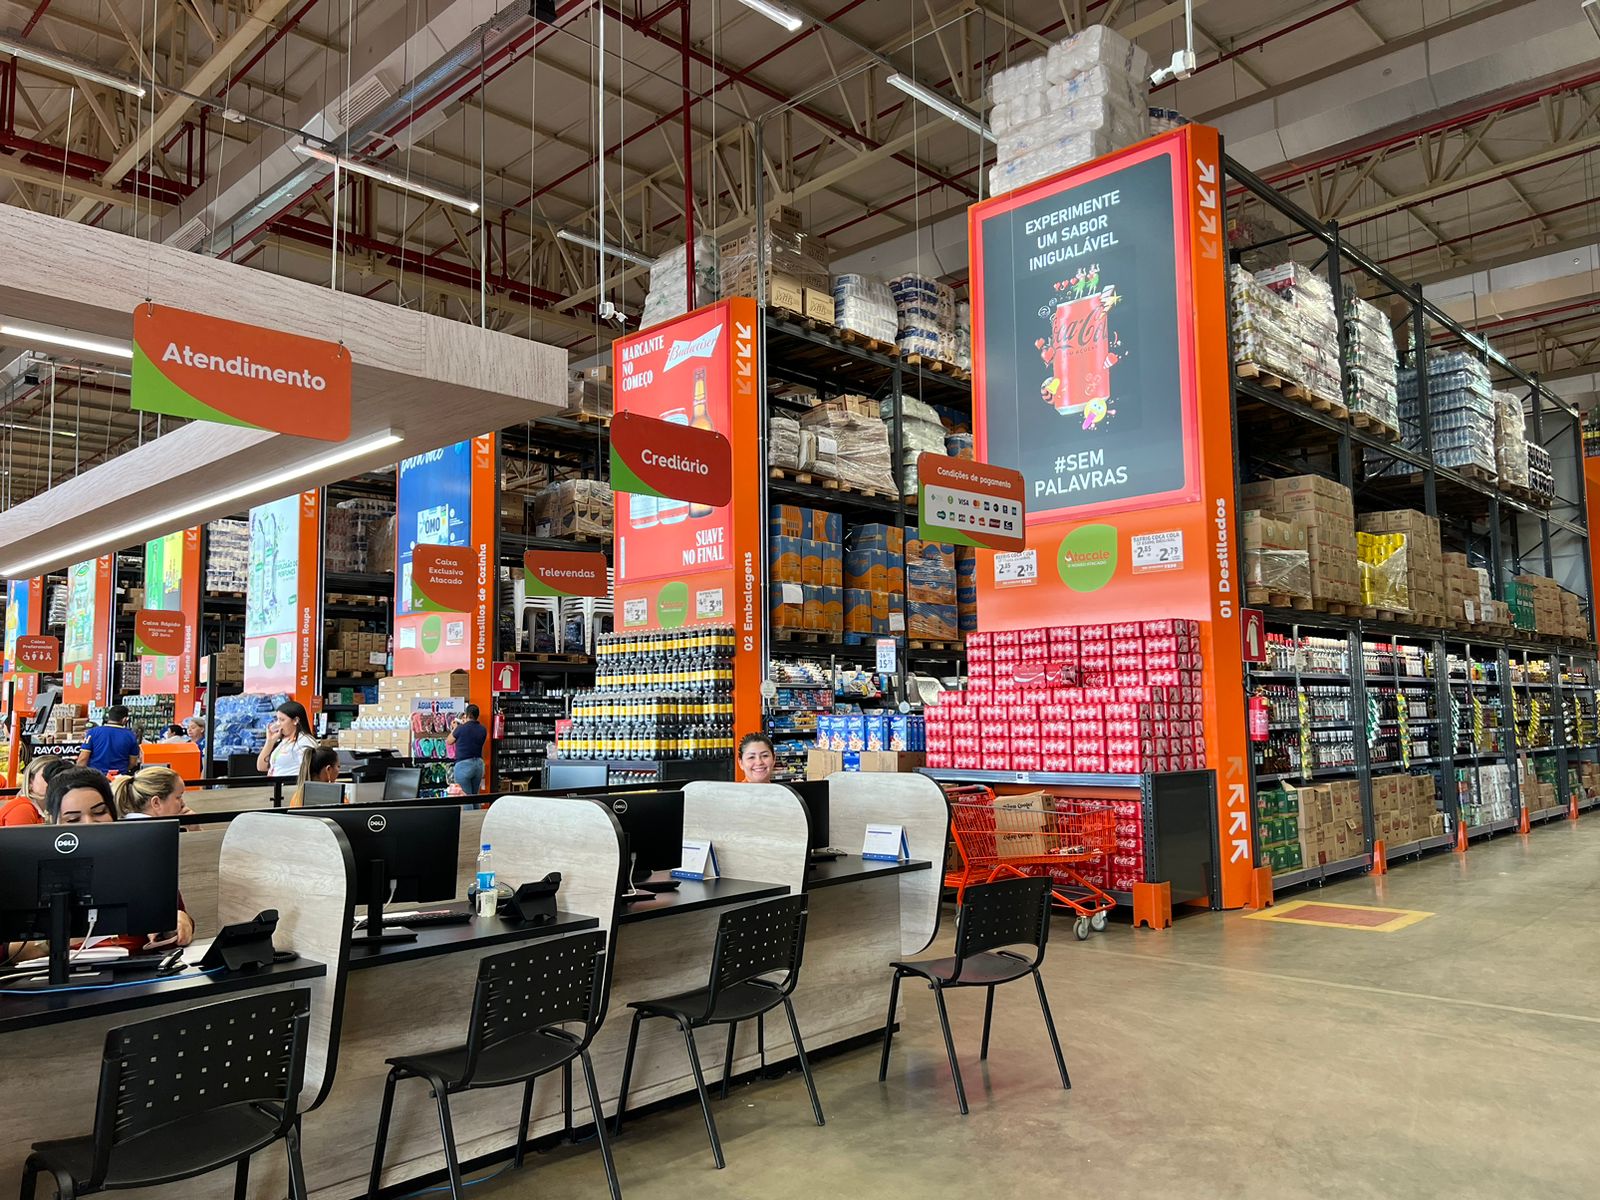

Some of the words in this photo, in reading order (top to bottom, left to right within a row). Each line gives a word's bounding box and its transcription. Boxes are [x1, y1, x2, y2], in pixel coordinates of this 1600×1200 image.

[1025, 190, 1121, 235] EXPERIMENTE
[1037, 233, 1058, 249] UM
[1061, 214, 1108, 241] SABOR
[1029, 232, 1119, 271] INIGUALÁVEL
[622, 335, 664, 361] MARCANTE
[670, 338, 717, 361] Budweiser
[162, 342, 327, 392] Atendimento
[622, 361, 634, 377] NO
[622, 370, 654, 391] COMEÇO
[641, 449, 709, 475] Crediário
[1054, 448, 1104, 474] #SEM
[937, 466, 969, 480] Condições
[970, 473, 978, 482] de
[980, 477, 1012, 489] pagamento
[1034, 466, 1128, 497] PALAVRAS
[958, 498, 970, 506] VISA
[425, 517, 441, 534] OMO
[695, 527, 724, 547] SUAVE
[1215, 498, 1230, 592] Destilados
[435, 558, 458, 566] Caixa
[478, 544, 487, 585] Cozinha
[682, 549, 695, 566] NO
[697, 544, 724, 564] FINAL
[428, 567, 464, 576] Exclusivo
[429, 577, 463, 585] Atacado
[539, 567, 595, 578] Televendas
[478, 588, 486, 602] de
[744, 552, 754, 631] Embalagens
[1220, 600, 1232, 618] 01
[302, 607, 310, 634] Roupa
[744, 635, 753, 651] 02
[301, 637, 309, 672] Limpeza
[477, 657, 485, 670] 03
[184, 655, 192, 683] Higiene
[183, 685, 190, 694] 05
[300, 675, 308, 686] 04
[33, 745, 81, 755] RAYOVAC
